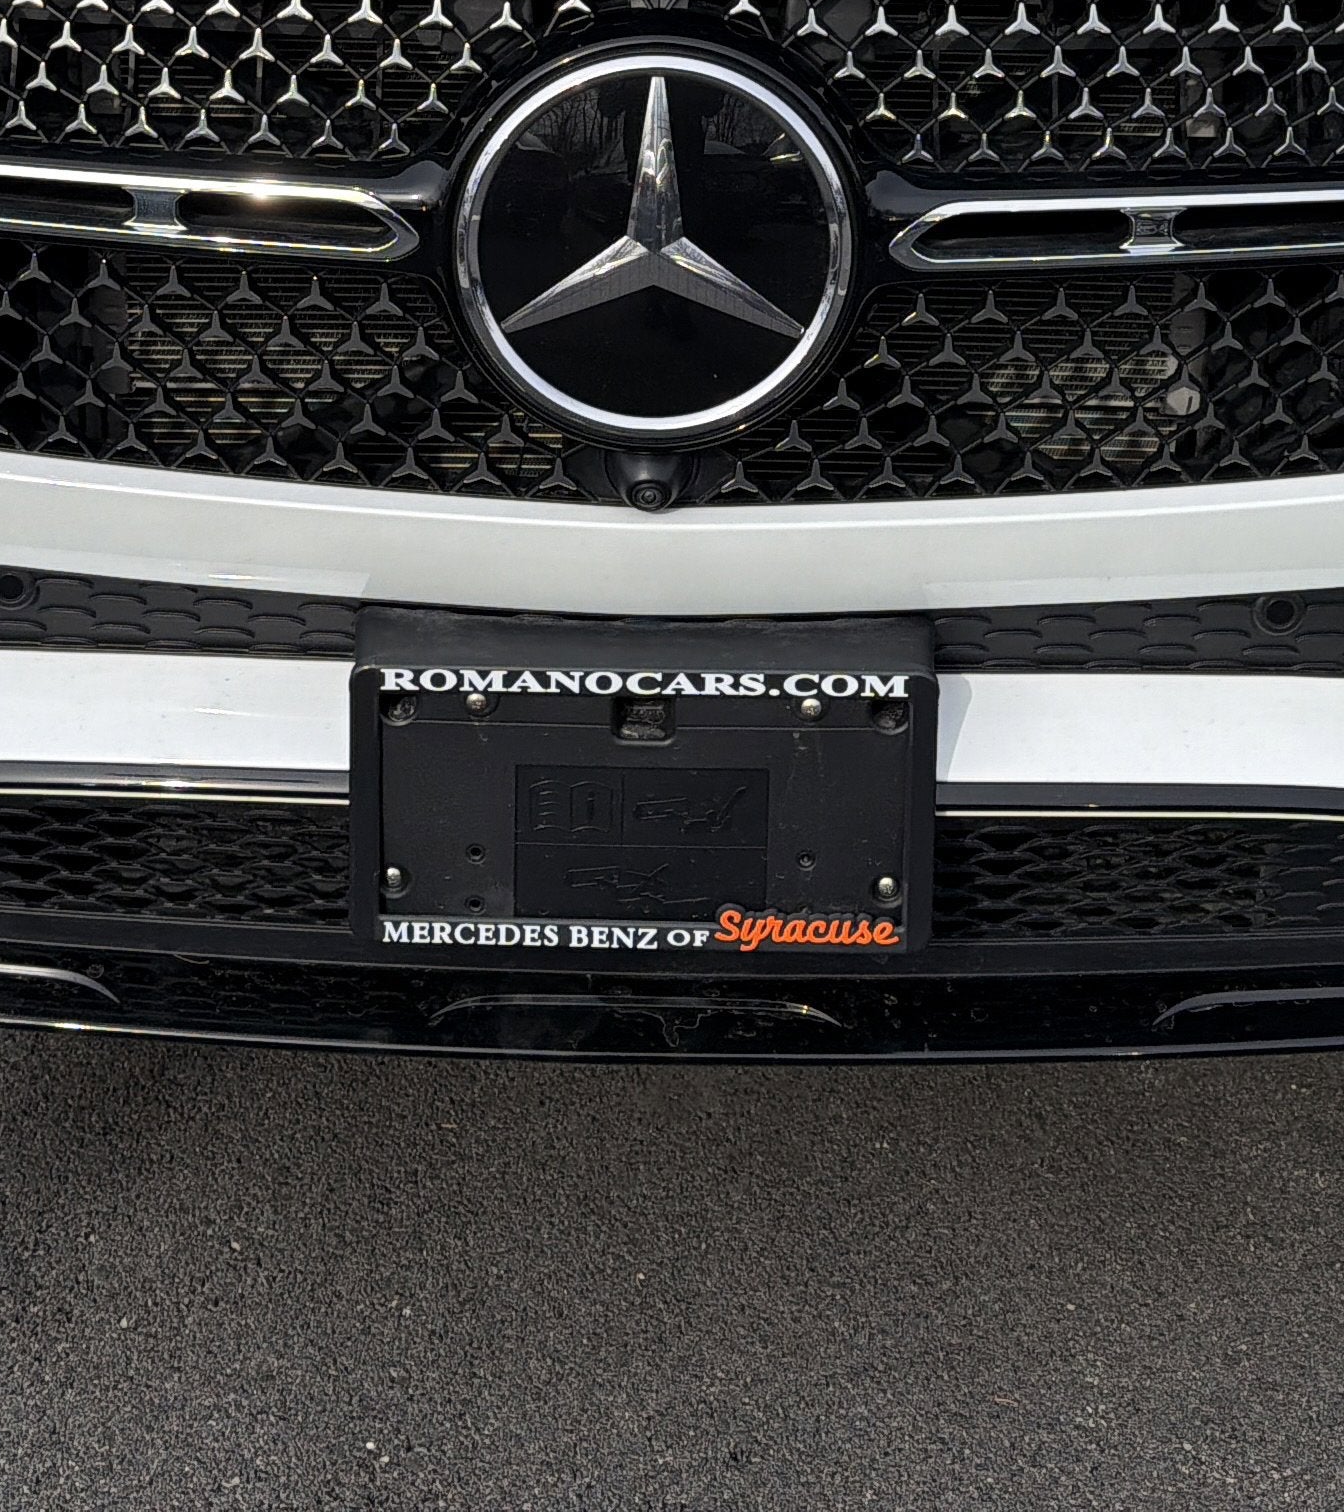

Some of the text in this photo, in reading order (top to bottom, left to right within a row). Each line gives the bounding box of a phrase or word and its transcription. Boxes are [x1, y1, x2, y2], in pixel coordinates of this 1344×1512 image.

[379, 668, 910, 698] ROMANOCARS.COM
[382, 909, 900, 953] MERCEDES BENZ OF Syracuse
